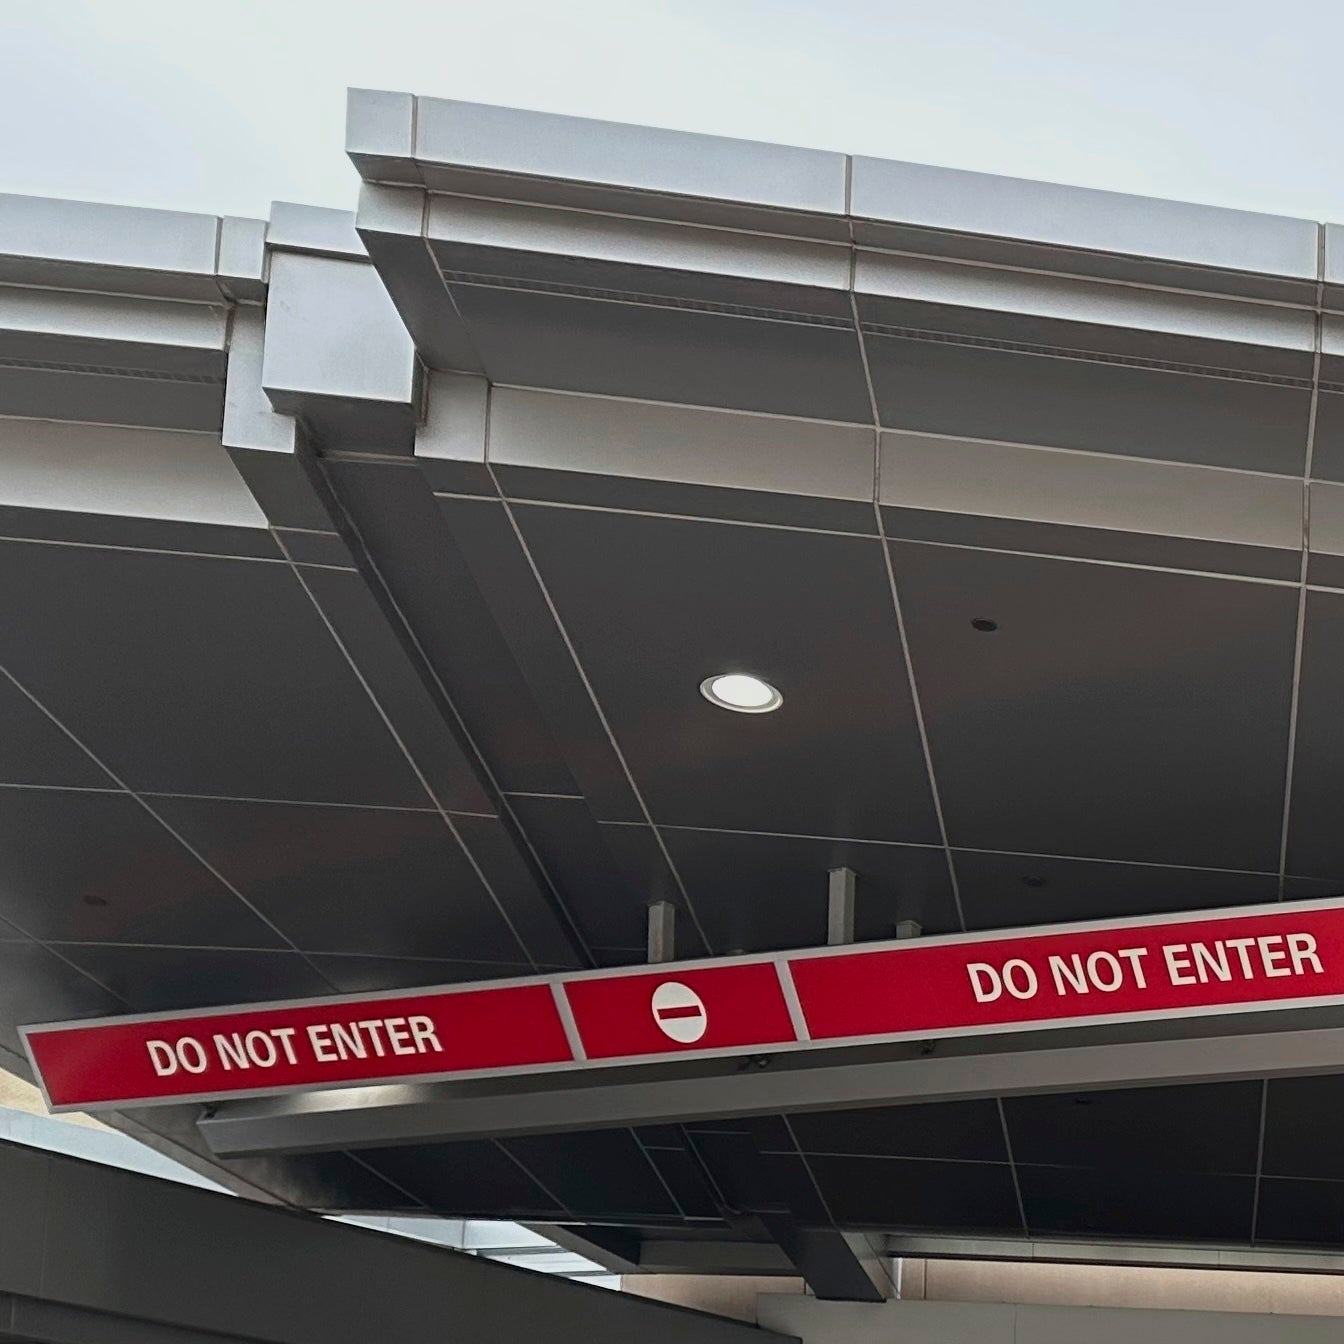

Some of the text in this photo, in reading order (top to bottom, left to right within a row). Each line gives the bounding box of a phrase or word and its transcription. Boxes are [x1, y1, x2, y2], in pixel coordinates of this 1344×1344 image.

[966, 932, 1325, 1003] DO NOT ENTER
[146, 1015, 443, 1076] DO NOT ENTER
